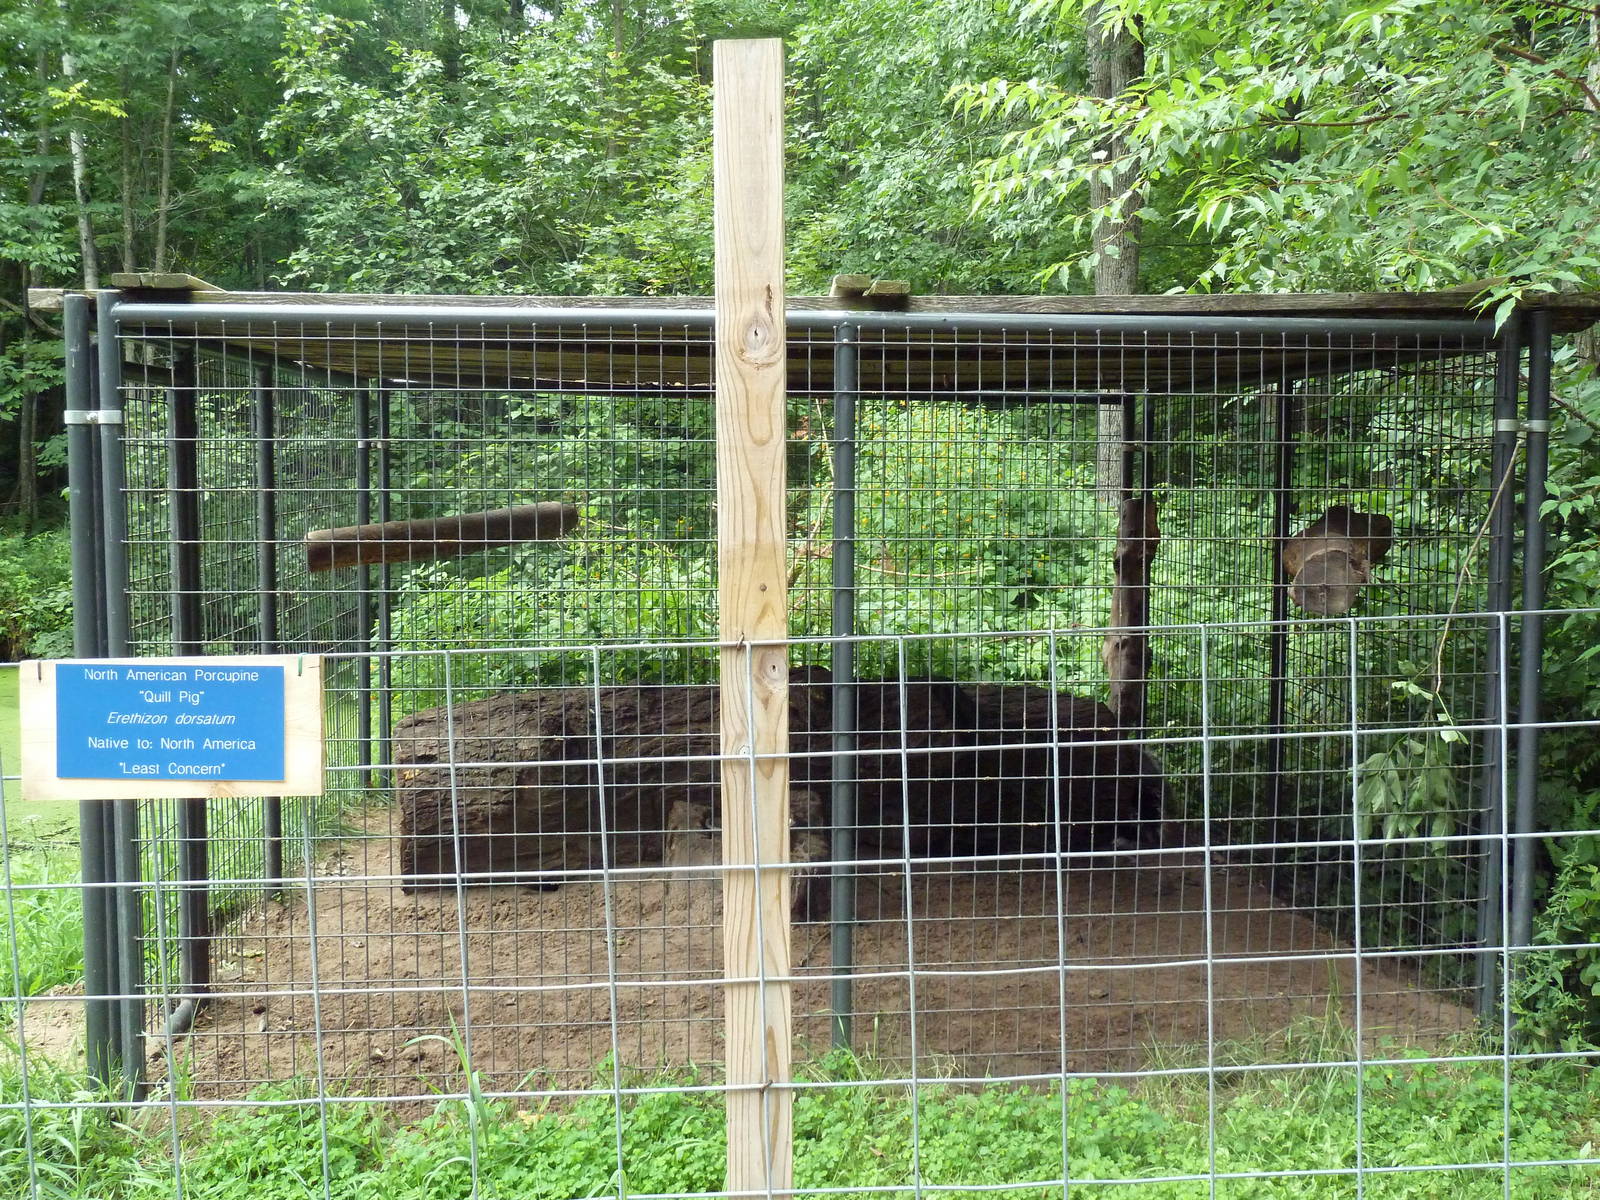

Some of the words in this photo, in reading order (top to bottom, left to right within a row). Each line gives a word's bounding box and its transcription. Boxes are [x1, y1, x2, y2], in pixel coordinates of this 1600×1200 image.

[84, 669, 118, 680] North
[126, 669, 187, 681] American
[194, 669, 259, 683] Porcupine
[139, 690, 171, 703] "Quill
[179, 690, 205, 706] Pig"
[107, 712, 168, 724] Erethizon
[175, 713, 237, 725] dorsatum
[88, 736, 129, 749] Native
[137, 738, 152, 750] to:
[160, 737, 195, 750] North
[203, 738, 256, 750] America
[119, 762, 160, 775] "Least
[168, 762, 224, 775] Concern"
